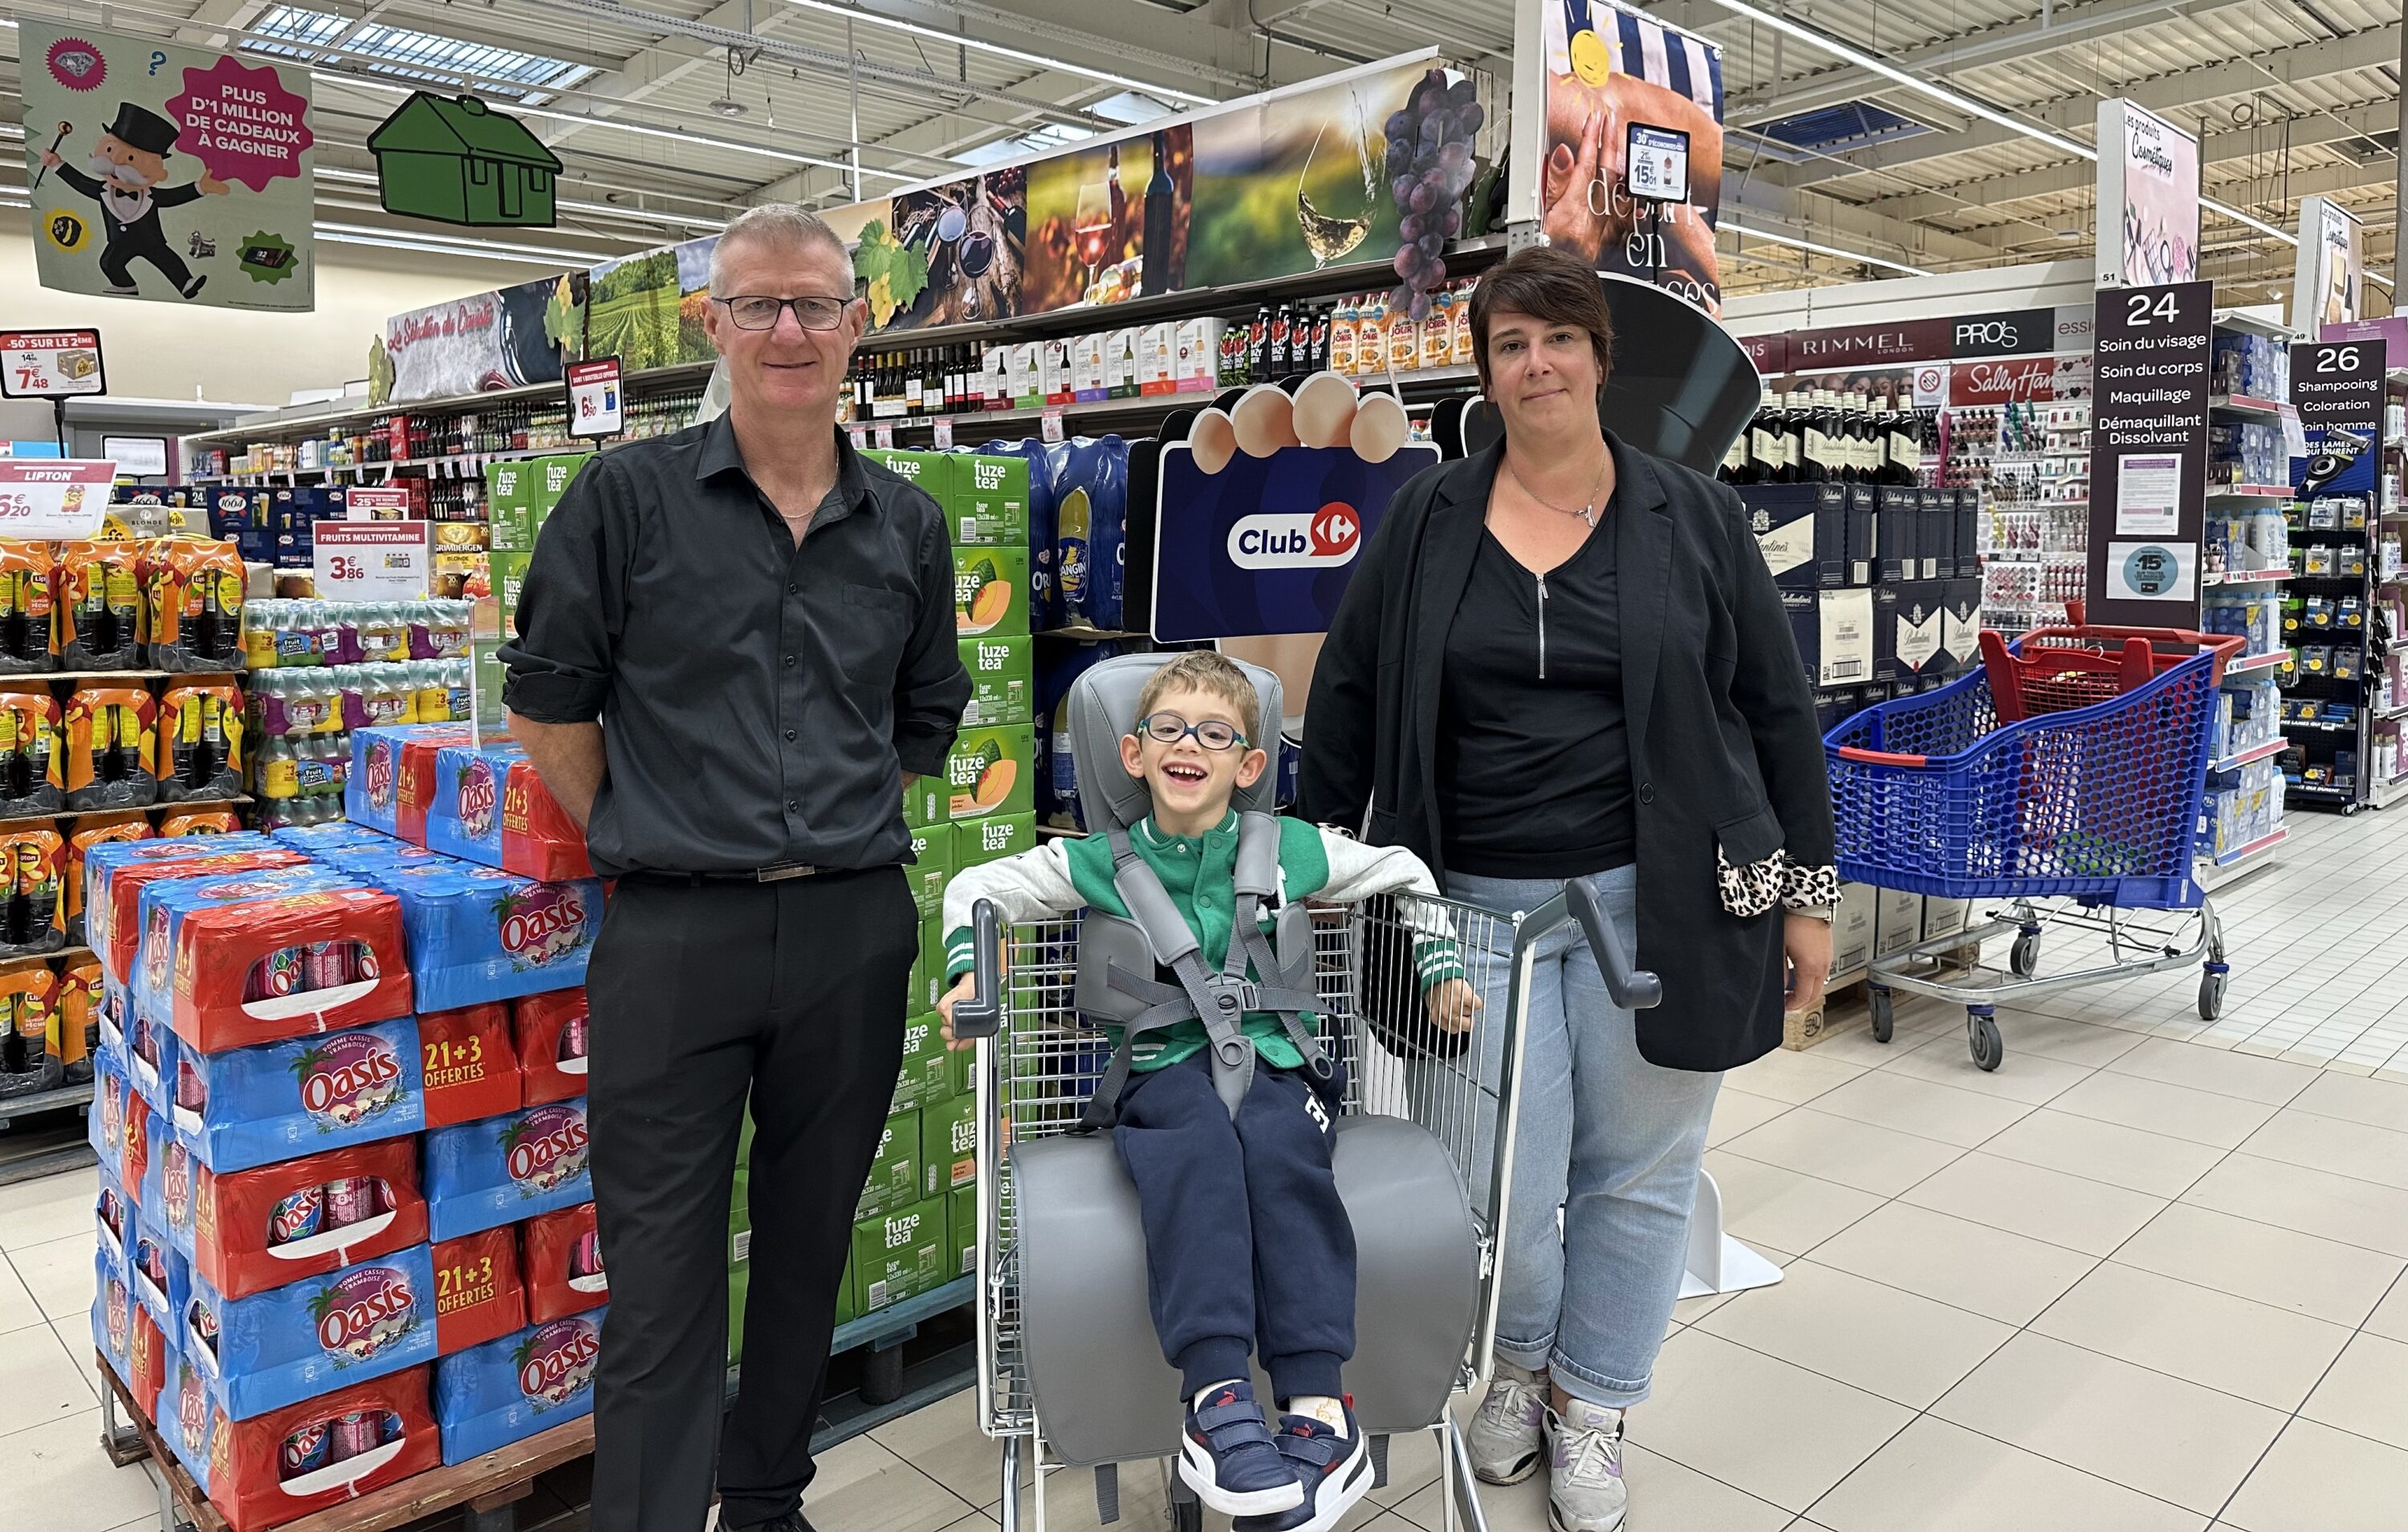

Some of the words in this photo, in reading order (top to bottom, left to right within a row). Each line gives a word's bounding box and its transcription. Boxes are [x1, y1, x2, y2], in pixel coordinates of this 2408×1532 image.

[222, 84, 266, 104] PLUS
[222, 102, 293, 126] MILLION
[185, 113, 210, 129] DE
[214, 119, 300, 144] CADEAUX
[2135, 118, 2160, 141] produits
[197, 129, 212, 148] À
[215, 136, 289, 160] GAGNER
[2131, 132, 2173, 174] Cosmétiques
[1626, 229, 1667, 269] en
[2102, 274, 2116, 282] 51
[2126, 291, 2180, 327] 24
[1956, 321, 2018, 348] PRO'S
[2059, 319, 2094, 335] essi
[31, 338, 53, 348] SUR
[56, 338, 68, 347] LE
[1803, 332, 1914, 356] RIMMEL
[1877, 347, 1914, 355] LONDON
[2100, 338, 2131, 352] Soin
[2134, 337, 2154, 350] du
[2158, 335, 2207, 349] visage
[2316, 346, 2360, 373] 26
[2101, 364, 2133, 379] Soin
[2135, 363, 2155, 376] du
[2158, 362, 2203, 376] corps
[1968, 364, 2016, 400] Sally
[2298, 379, 2378, 392] Shampooing
[2110, 388, 2191, 405] Maquillage
[2304, 400, 2370, 412] Coloration
[2099, 414, 2202, 431] Démaquillant
[2326, 421, 2377, 432] homme
[2109, 430, 2190, 445] Dissolvant
[2305, 448, 2321, 456] QUI
[2325, 447, 2359, 455] DURENT
[24, 471, 73, 482] LIPTON
[497, 467, 517, 484] fuze
[547, 461, 567, 479] fuze
[974, 459, 1006, 478] fuze
[496, 482, 514, 496] tea
[547, 478, 562, 492] tea
[974, 476, 999, 490] tea
[193, 492, 205, 502] 24
[221, 498, 243, 508] 1664
[320, 534, 352, 542] FRUITS
[352, 533, 420, 542] MULTIVITAMINE
[1239, 528, 1307, 555] Club
[503, 575, 521, 593] fuze
[504, 593, 518, 606] tea
[283, 637, 301, 647] Fruit
[978, 641, 1010, 658] fuze
[978, 657, 1003, 671] tea
[949, 754, 985, 772] fuze
[305, 768, 322, 778] Fruit
[366, 756, 393, 794] Oasis
[397, 764, 415, 790] 21+3
[950, 770, 977, 786] tea
[458, 775, 495, 820] Oasis
[504, 786, 528, 815] 21+3
[502, 814, 528, 833] OFFERTES
[982, 822, 1014, 839] fuze
[982, 835, 1007, 851] tea
[501, 893, 585, 953] Oasis
[146, 926, 169, 969] Oasis
[323, 1037, 348, 1052] POMME
[349, 1034, 371, 1043] CASSIS
[329, 1041, 367, 1056] FRAMBOISE
[425, 1034, 482, 1071] 21+3
[303, 1046, 400, 1113] Oasis
[425, 1065, 485, 1087] OFFERTES
[526, 1109, 547, 1124] POMME
[548, 1107, 566, 1115] CASSIS
[531, 1113, 563, 1127] FRAMBOISE
[951, 1120, 975, 1138] fuz
[508, 1118, 588, 1180] Oasis
[162, 1163, 189, 1202] Oasis
[274, 1187, 323, 1241] Oasis
[885, 1213, 920, 1234] fuze
[885, 1229, 912, 1249] tea
[339, 1272, 362, 1289] POMME
[364, 1269, 386, 1278] CASSIS
[344, 1275, 381, 1291] FRAMBOISE
[437, 1257, 493, 1297] 21+3
[437, 1282, 494, 1314] OFFERTES
[319, 1279, 413, 1351] Oasis
[536, 1323, 558, 1339] POMME
[559, 1319, 576, 1327] CASSIS
[542, 1326, 572, 1342] FRAMBOISE
[520, 1328, 600, 1396] Oasis
